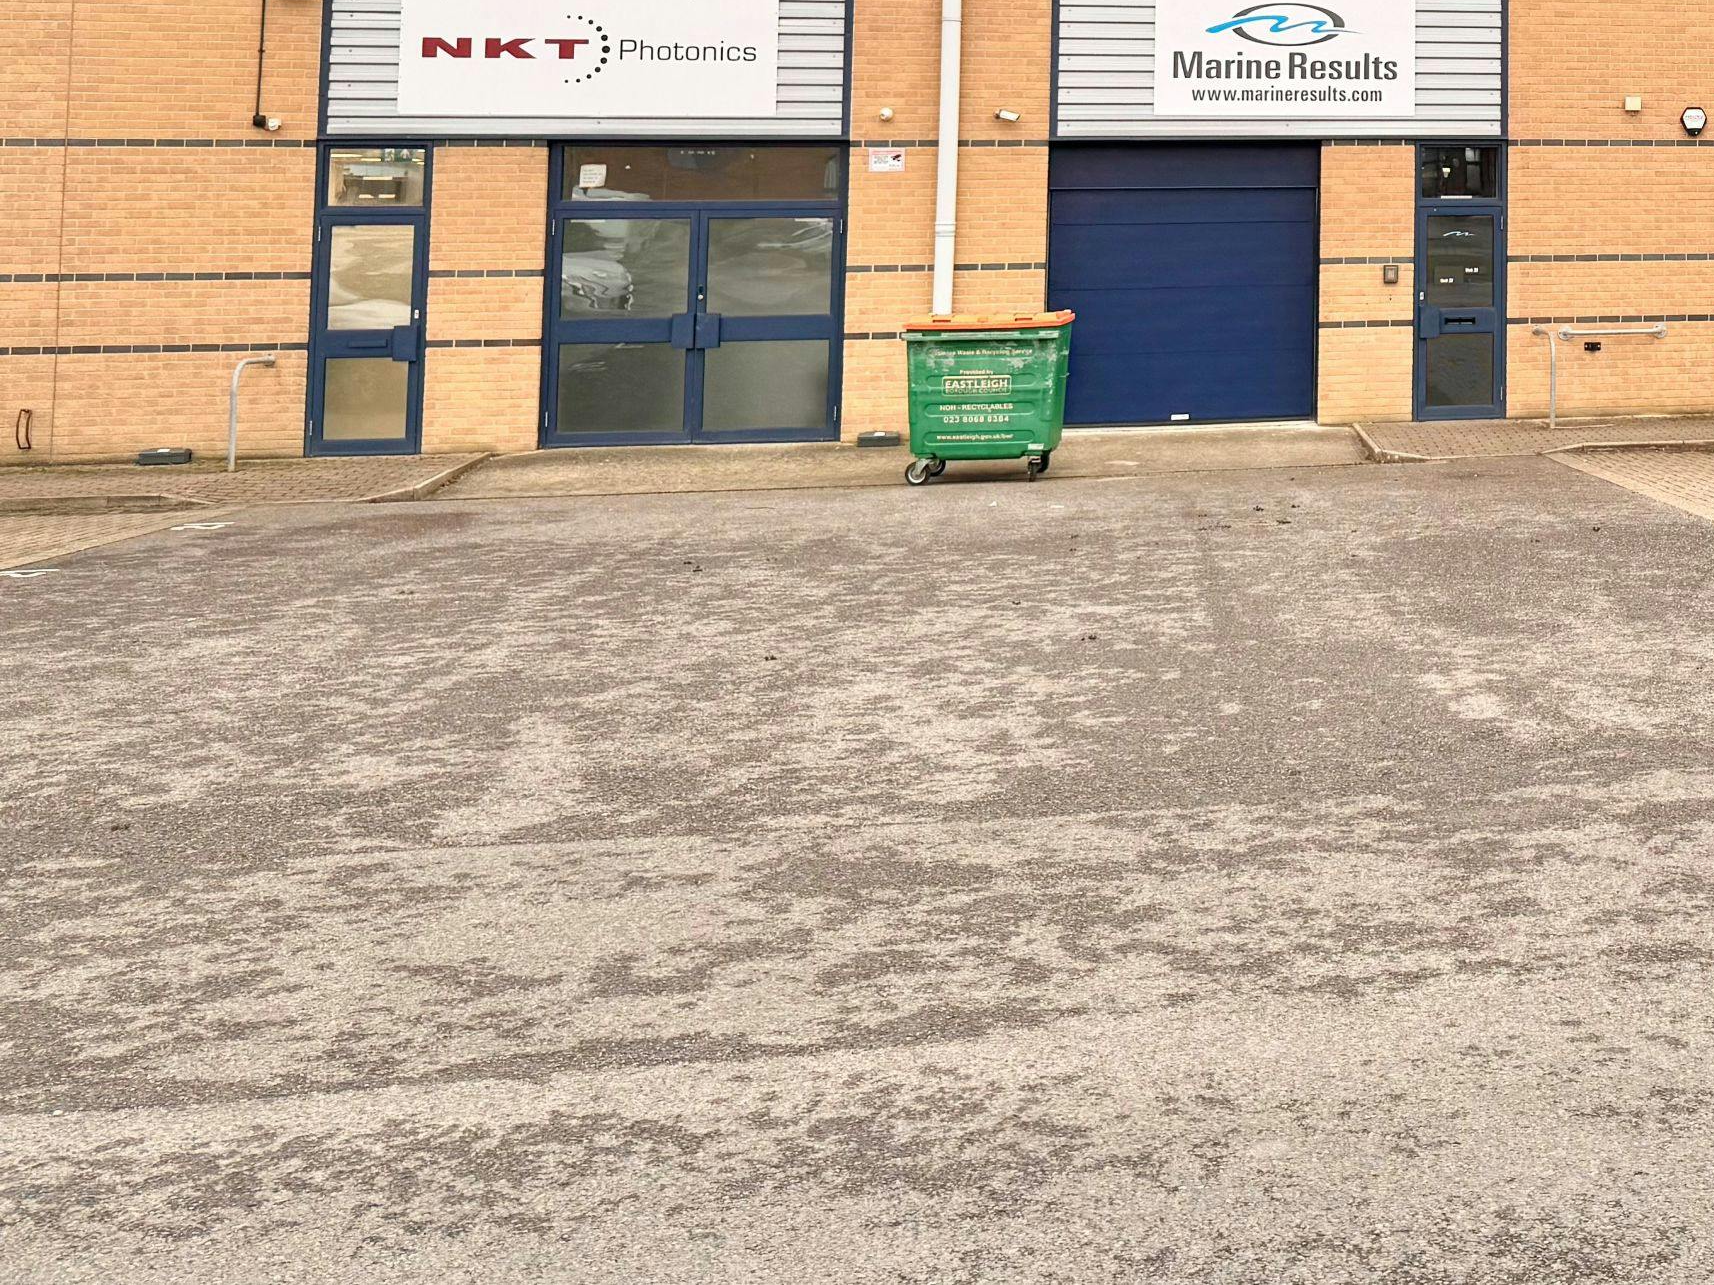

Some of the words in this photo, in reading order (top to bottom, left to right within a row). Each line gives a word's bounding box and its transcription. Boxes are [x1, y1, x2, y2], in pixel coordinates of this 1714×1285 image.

[421, 37, 589, 60] NKT
[619, 39, 757, 62] Photonics
[1172, 51, 1281, 79] Marine
[1288, 52, 1398, 81] Results
[1191, 85, 1383, 102] www.marineresults.com
[945, 378, 1008, 389] EASTLEIGH
[962, 402, 1014, 411] RECYCLABLES
[943, 416, 960, 424] 023
